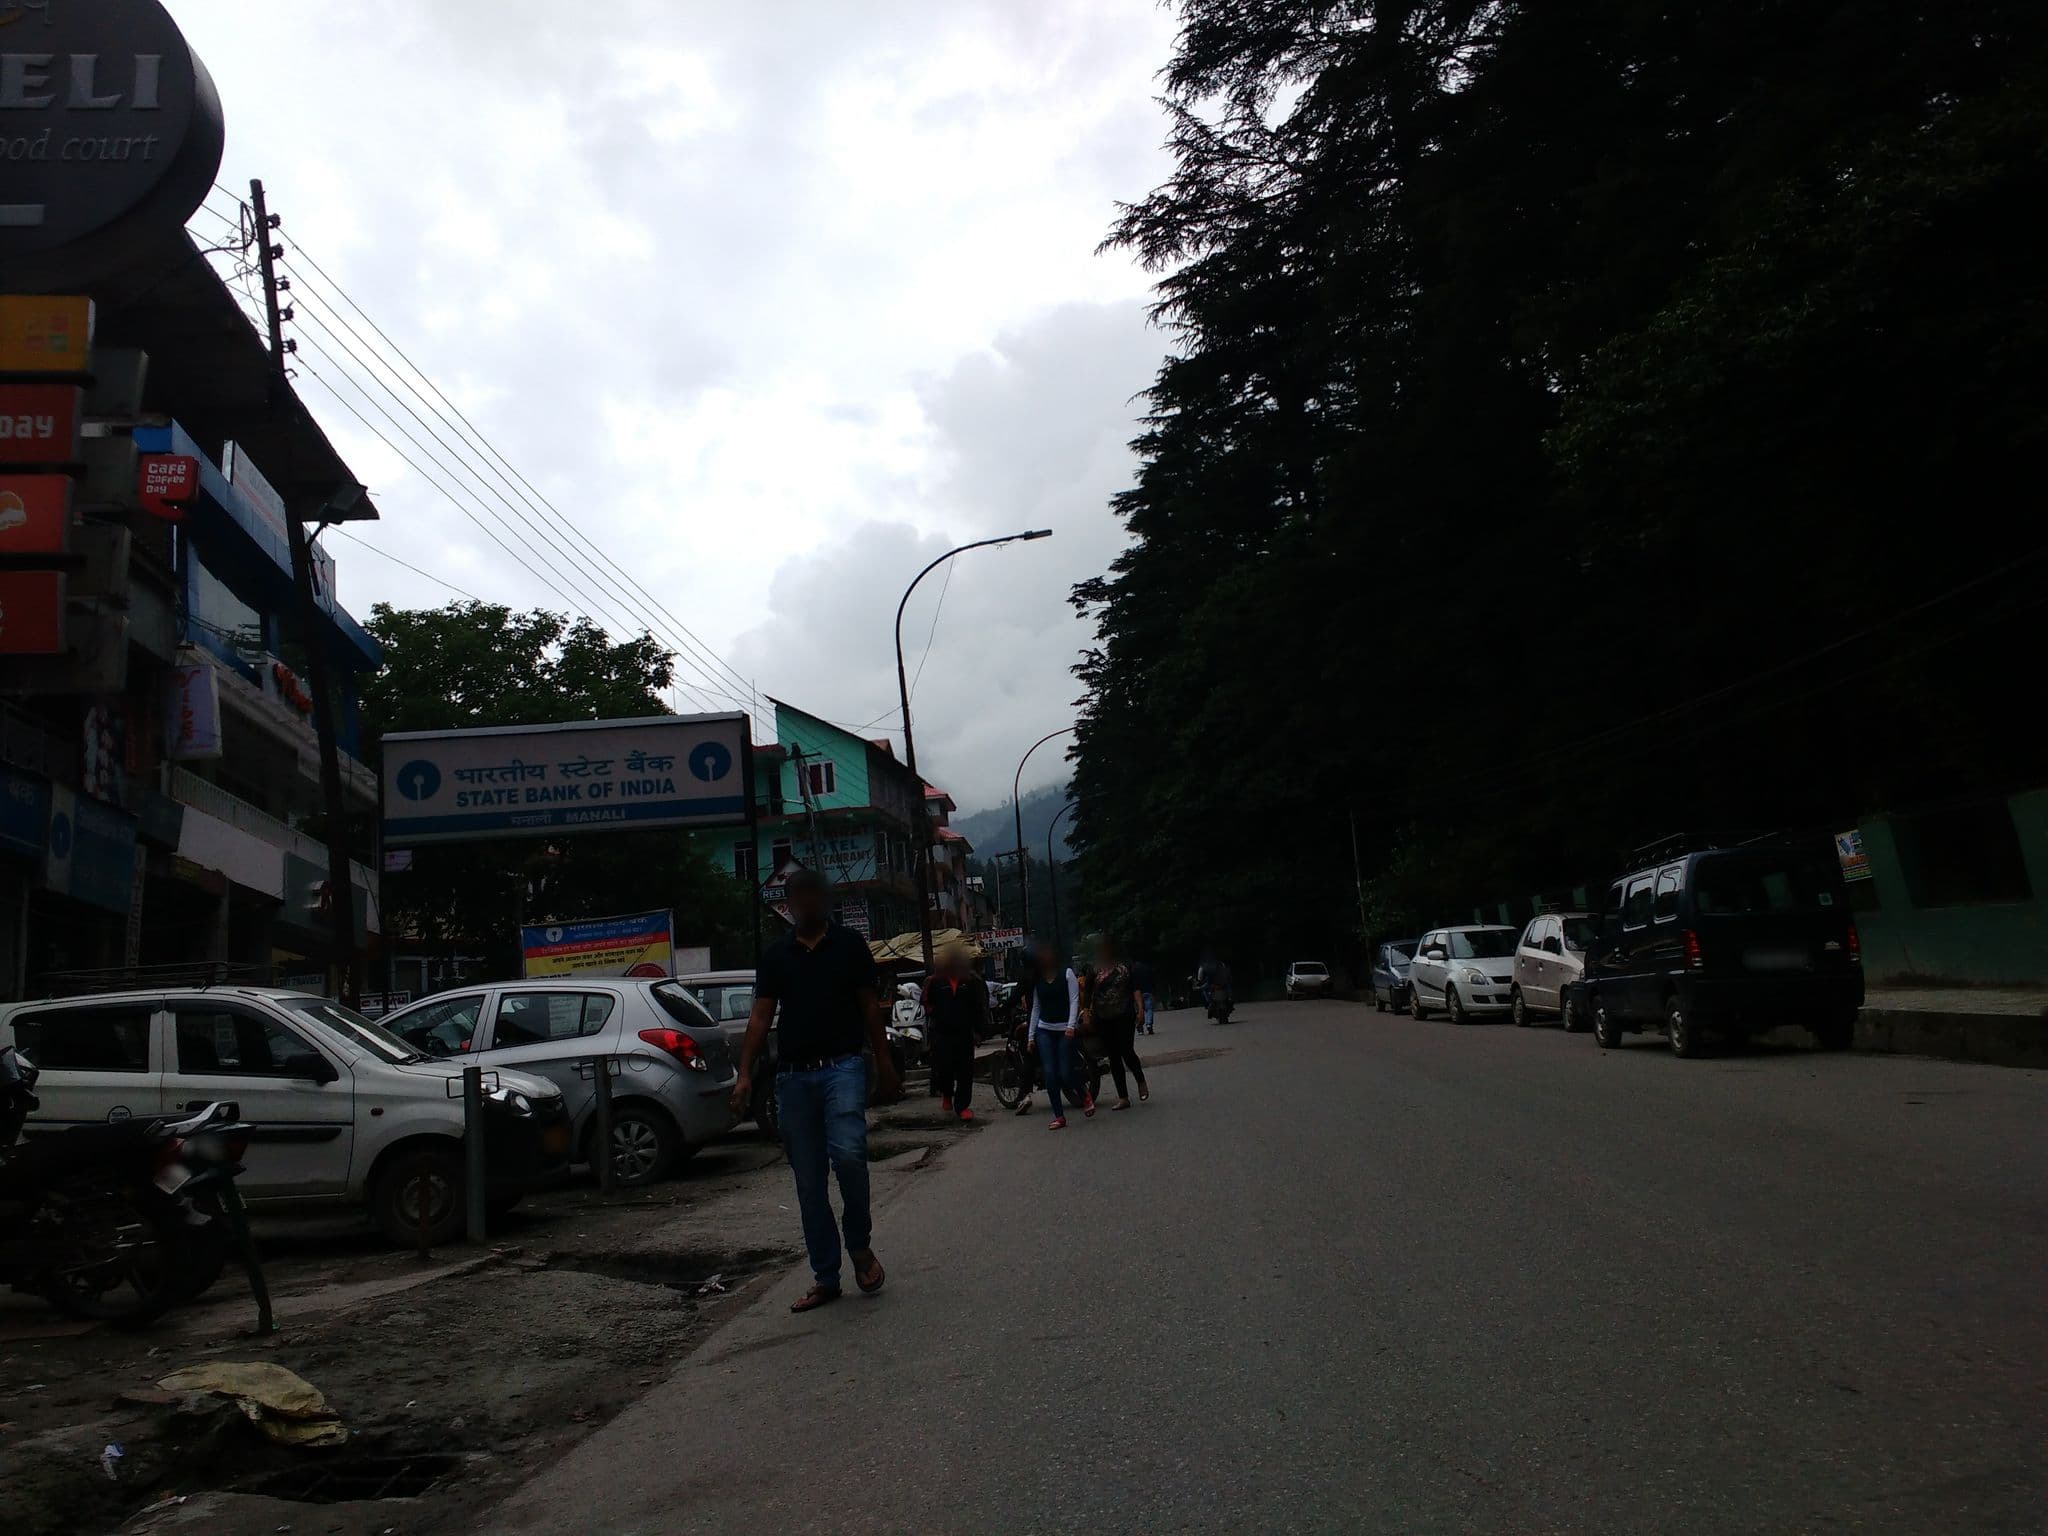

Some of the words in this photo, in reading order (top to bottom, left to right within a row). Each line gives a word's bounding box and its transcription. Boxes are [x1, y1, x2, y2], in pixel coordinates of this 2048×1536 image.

[62, 133, 159, 160] court
[454, 759, 548, 784] भारतीय
[558, 755, 614, 778] स्टेट
[624, 750, 675, 773] बैंक
[456, 788, 519, 807] STATE
[526, 784, 582, 803] BANK
[588, 782, 613, 798] OF
[621, 778, 676, 796] INDIA
[565, 807, 626, 823] MANALI
[806, 839, 858, 853] HOTEL
[802, 849, 871, 865] RETAURANT
[995, 928, 1021, 938] HOTEL
